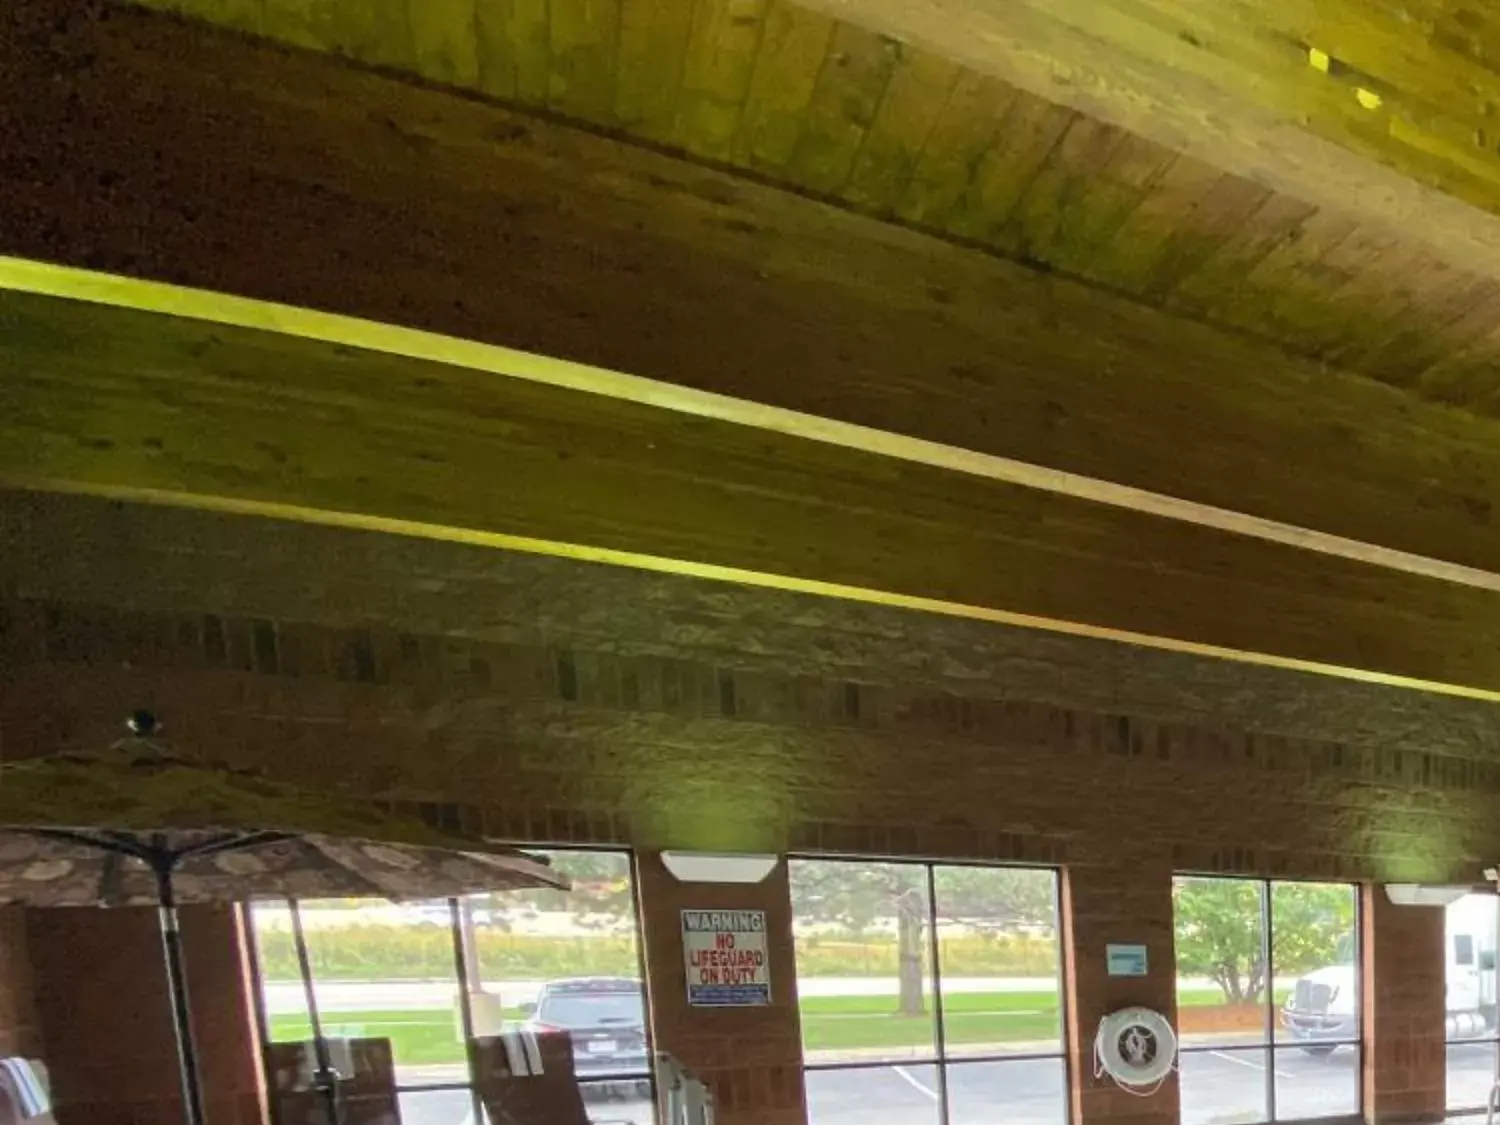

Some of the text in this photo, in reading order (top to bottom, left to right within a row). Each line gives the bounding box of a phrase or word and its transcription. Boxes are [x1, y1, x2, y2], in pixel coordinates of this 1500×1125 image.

[685, 912, 763, 931] WARNING
[715, 933, 735, 949] NO
[691, 950, 763, 967] LIFEGUARD
[701, 967, 755, 984] ON DUTY
